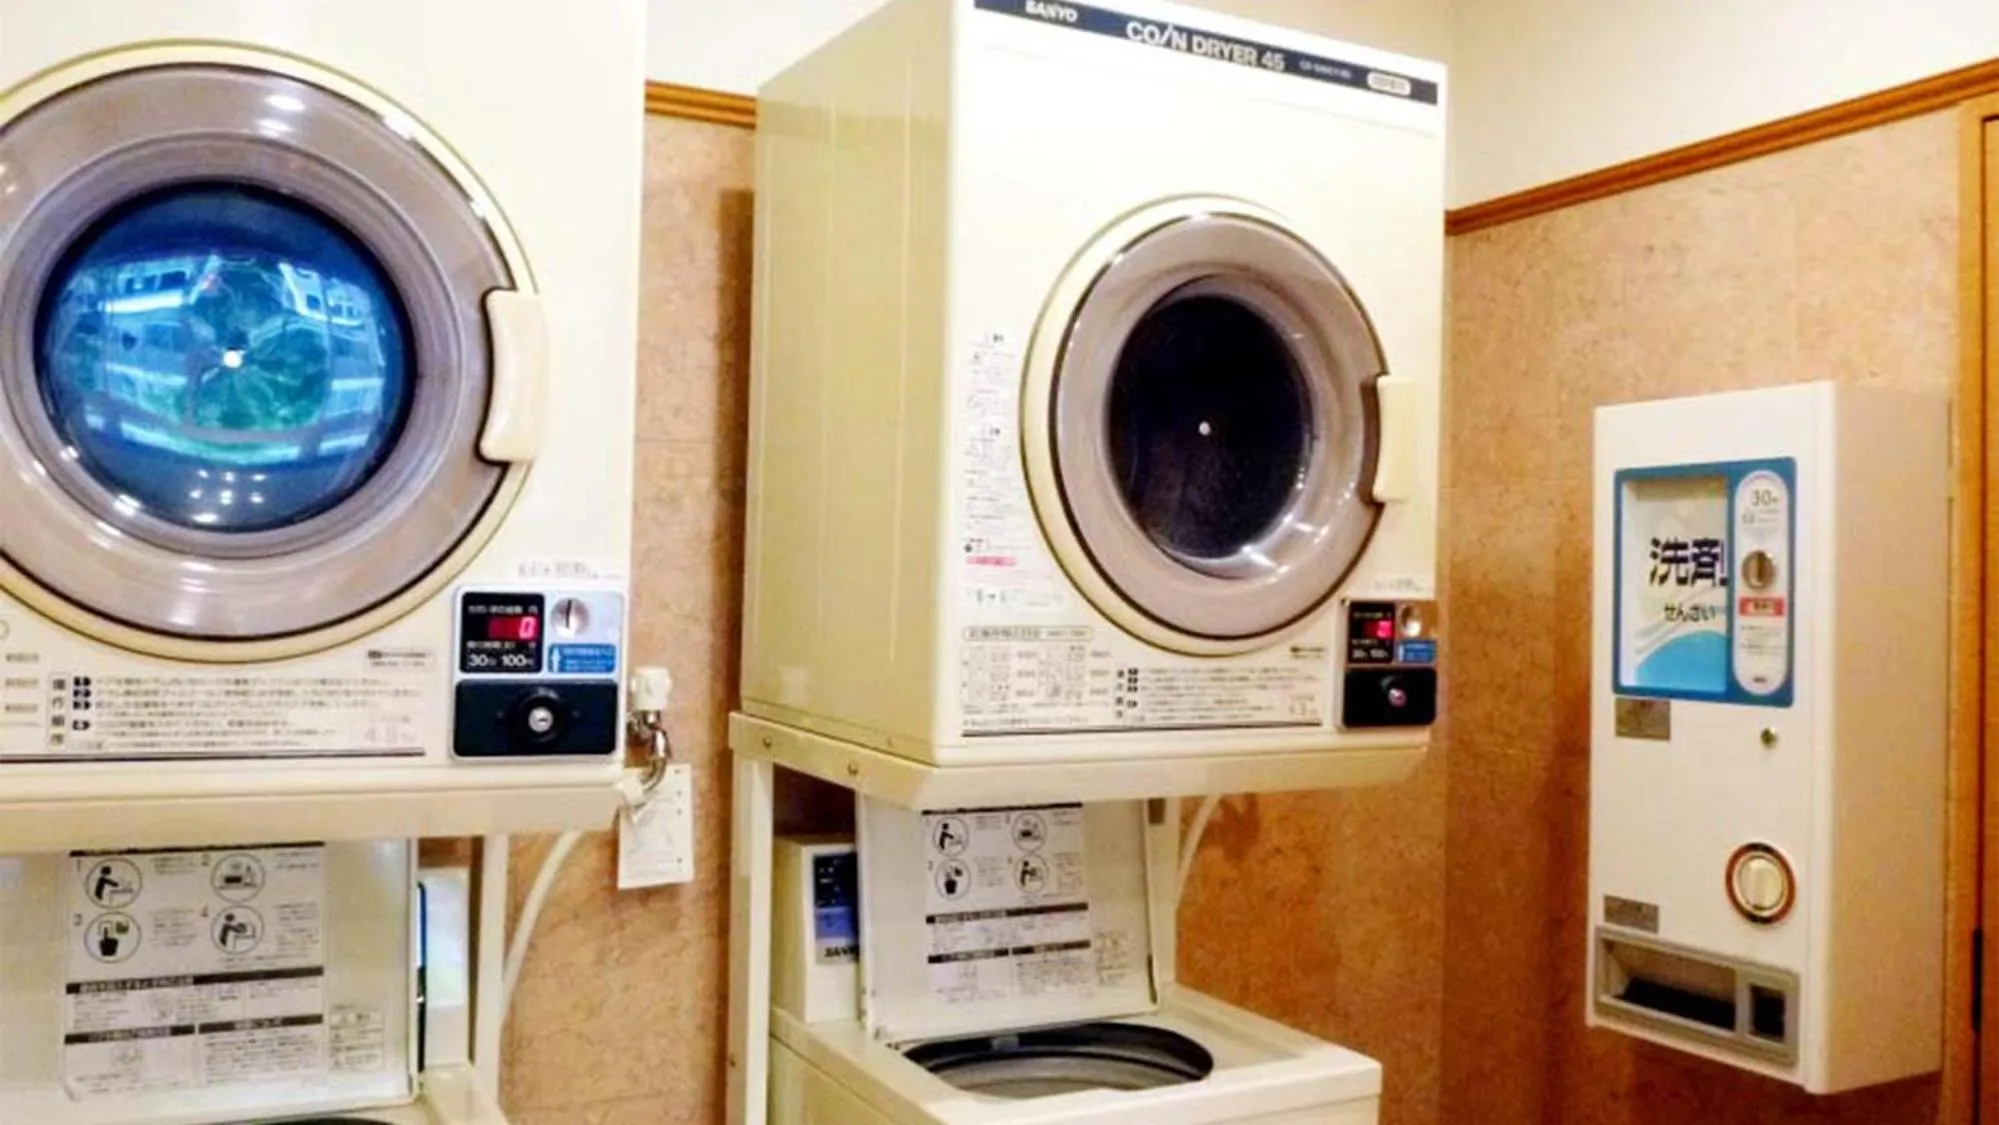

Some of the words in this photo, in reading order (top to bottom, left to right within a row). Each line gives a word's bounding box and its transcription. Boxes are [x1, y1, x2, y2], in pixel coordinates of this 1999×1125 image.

[1192, 35, 1258, 66] DRYER
[1261, 52, 1285, 72] 45
[519, 616, 537, 640] 0
